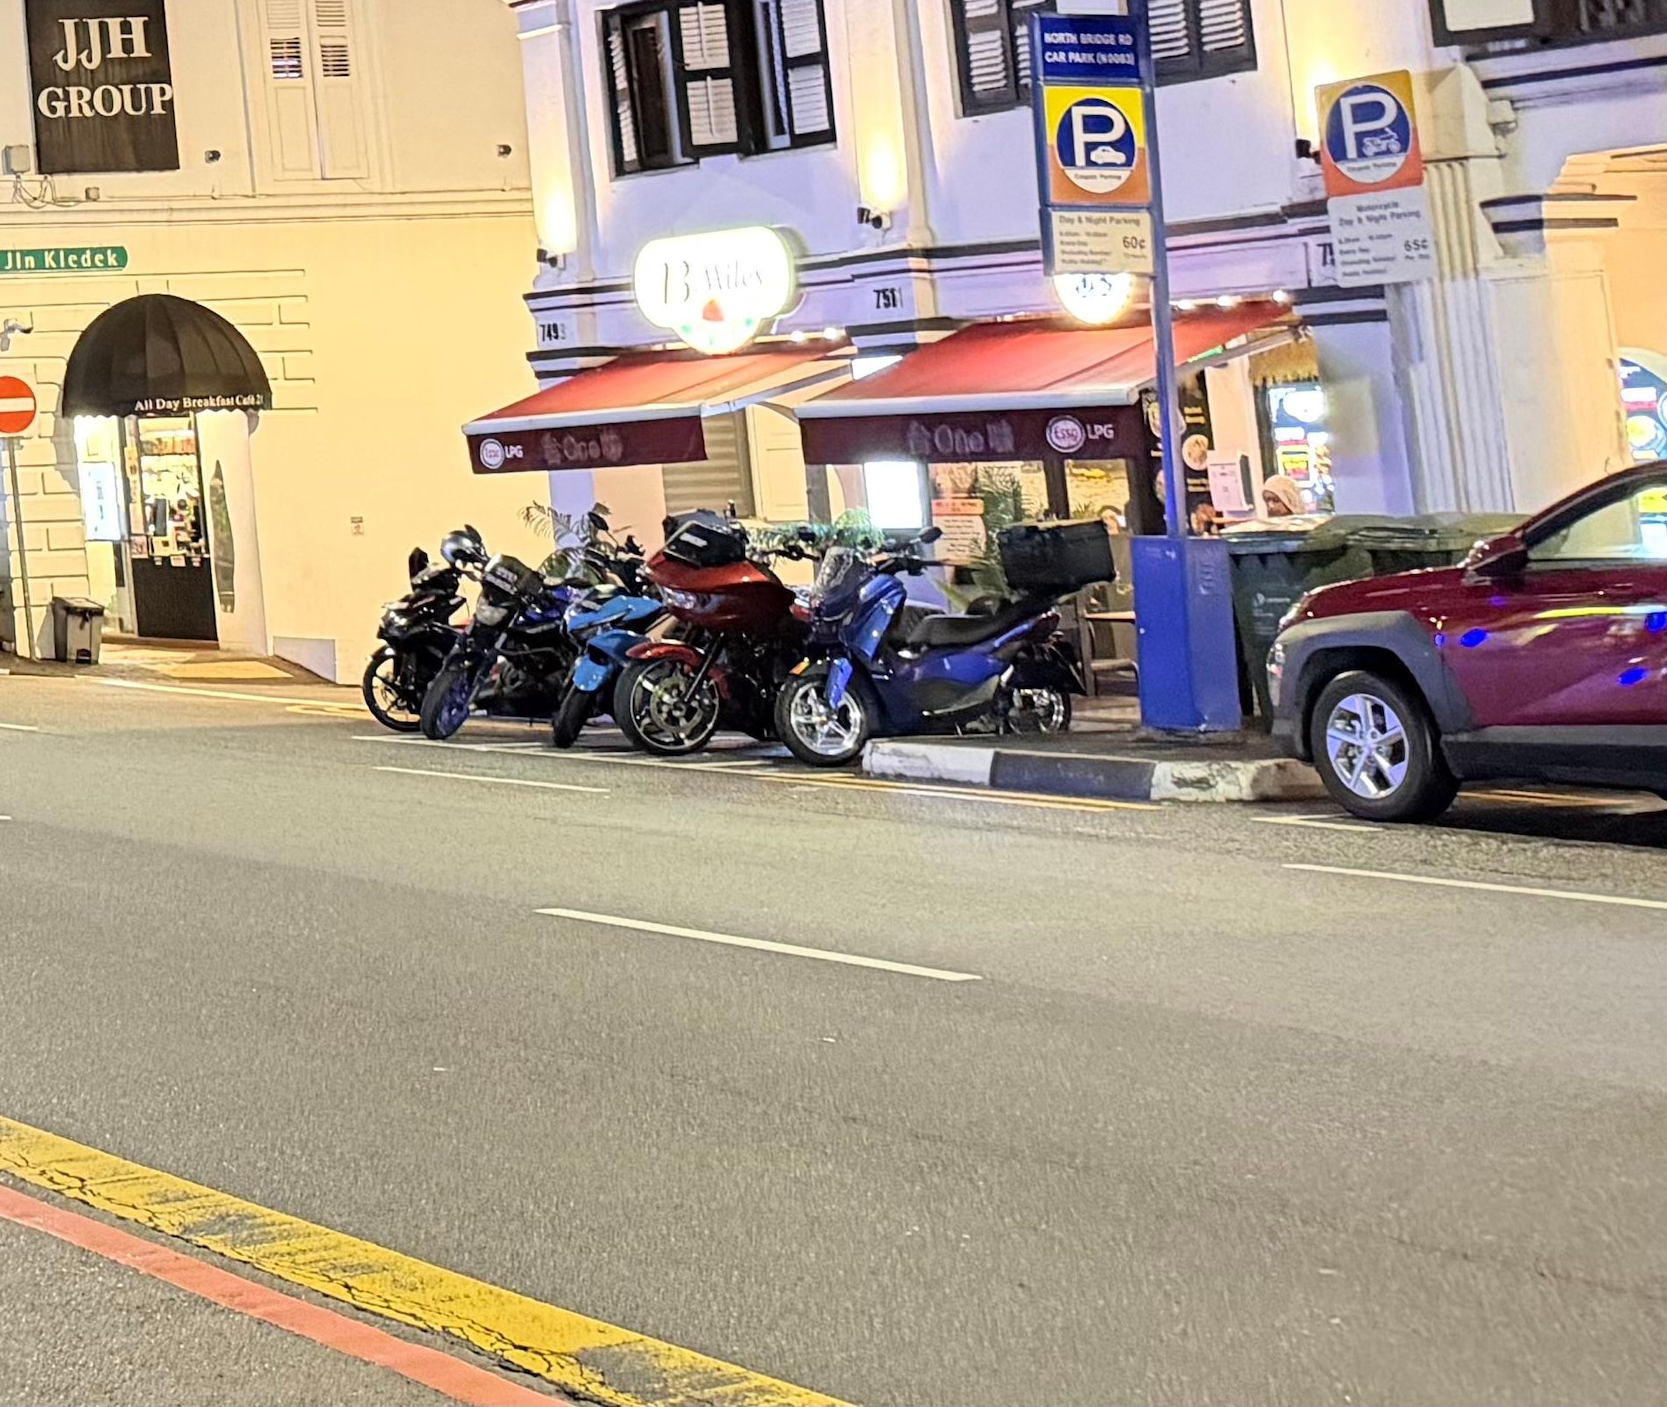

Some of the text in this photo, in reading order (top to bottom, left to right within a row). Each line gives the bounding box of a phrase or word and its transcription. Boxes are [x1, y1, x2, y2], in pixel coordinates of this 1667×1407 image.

[53, 17, 152, 72] JJH
[1044, 32, 1078, 44] NORTH
[1080, 33, 1117, 45] BRIDGE
[1045, 51, 1067, 63] CAR
[1068, 51, 1095, 63] PARK
[38, 83, 173, 119] GROUP
[1340, 92, 1398, 159] P
[1071, 105, 1126, 167] P
[1059, 215, 1075, 225] Day
[1085, 215, 1108, 226] Night
[1109, 216, 1141, 228] Parking
[4, 249, 119, 270] Jln Kledek
[134, 399, 153, 411] All
[156, 398, 180, 412] Day
[183, 395, 234, 408] Breakfast
[1085, 423, 1115, 440] LPG
